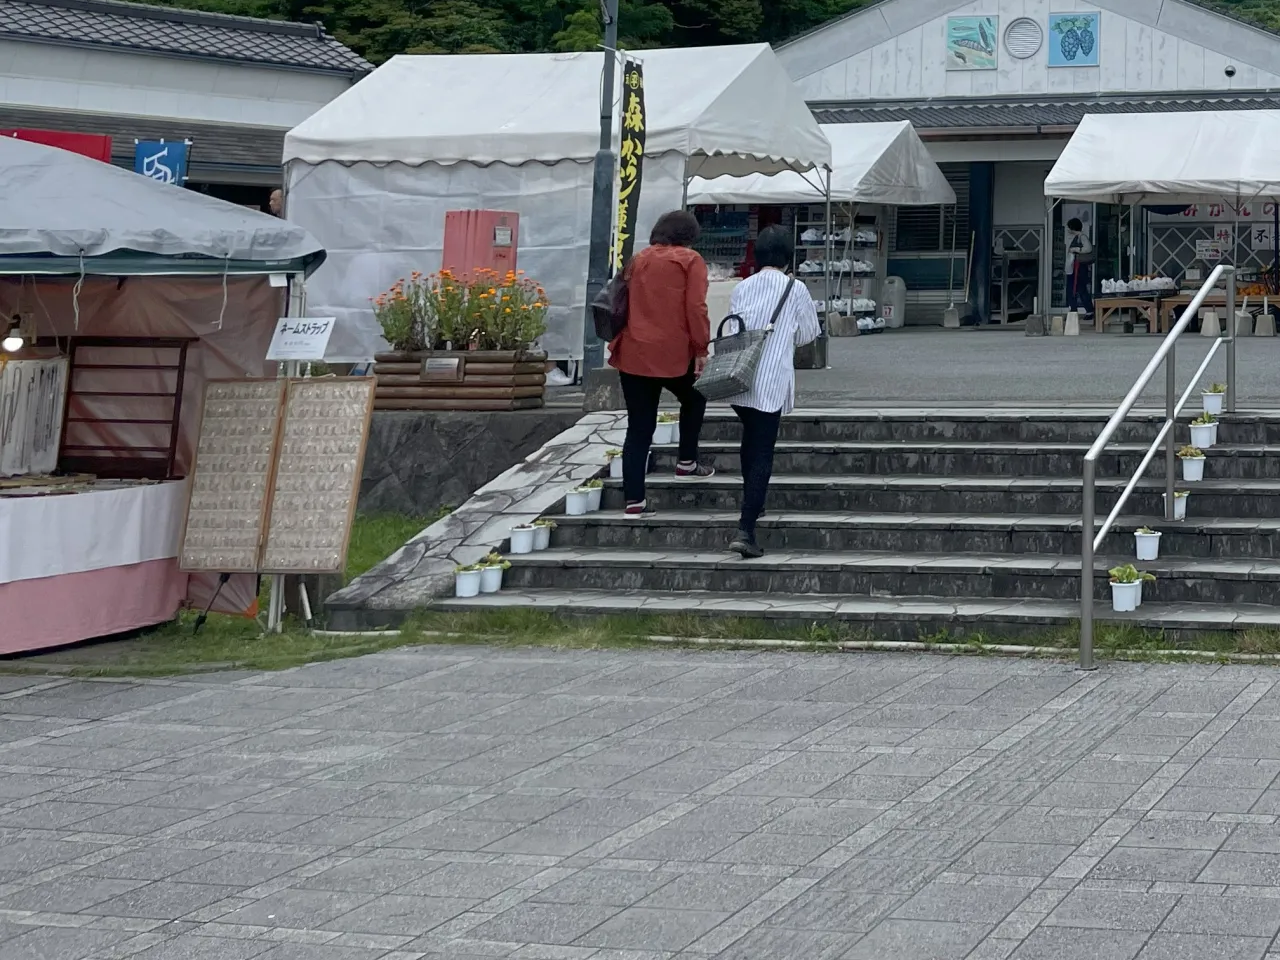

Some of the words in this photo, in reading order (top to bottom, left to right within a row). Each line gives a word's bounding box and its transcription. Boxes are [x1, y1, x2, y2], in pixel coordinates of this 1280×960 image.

[280, 321, 330, 335] ネームストラップ
